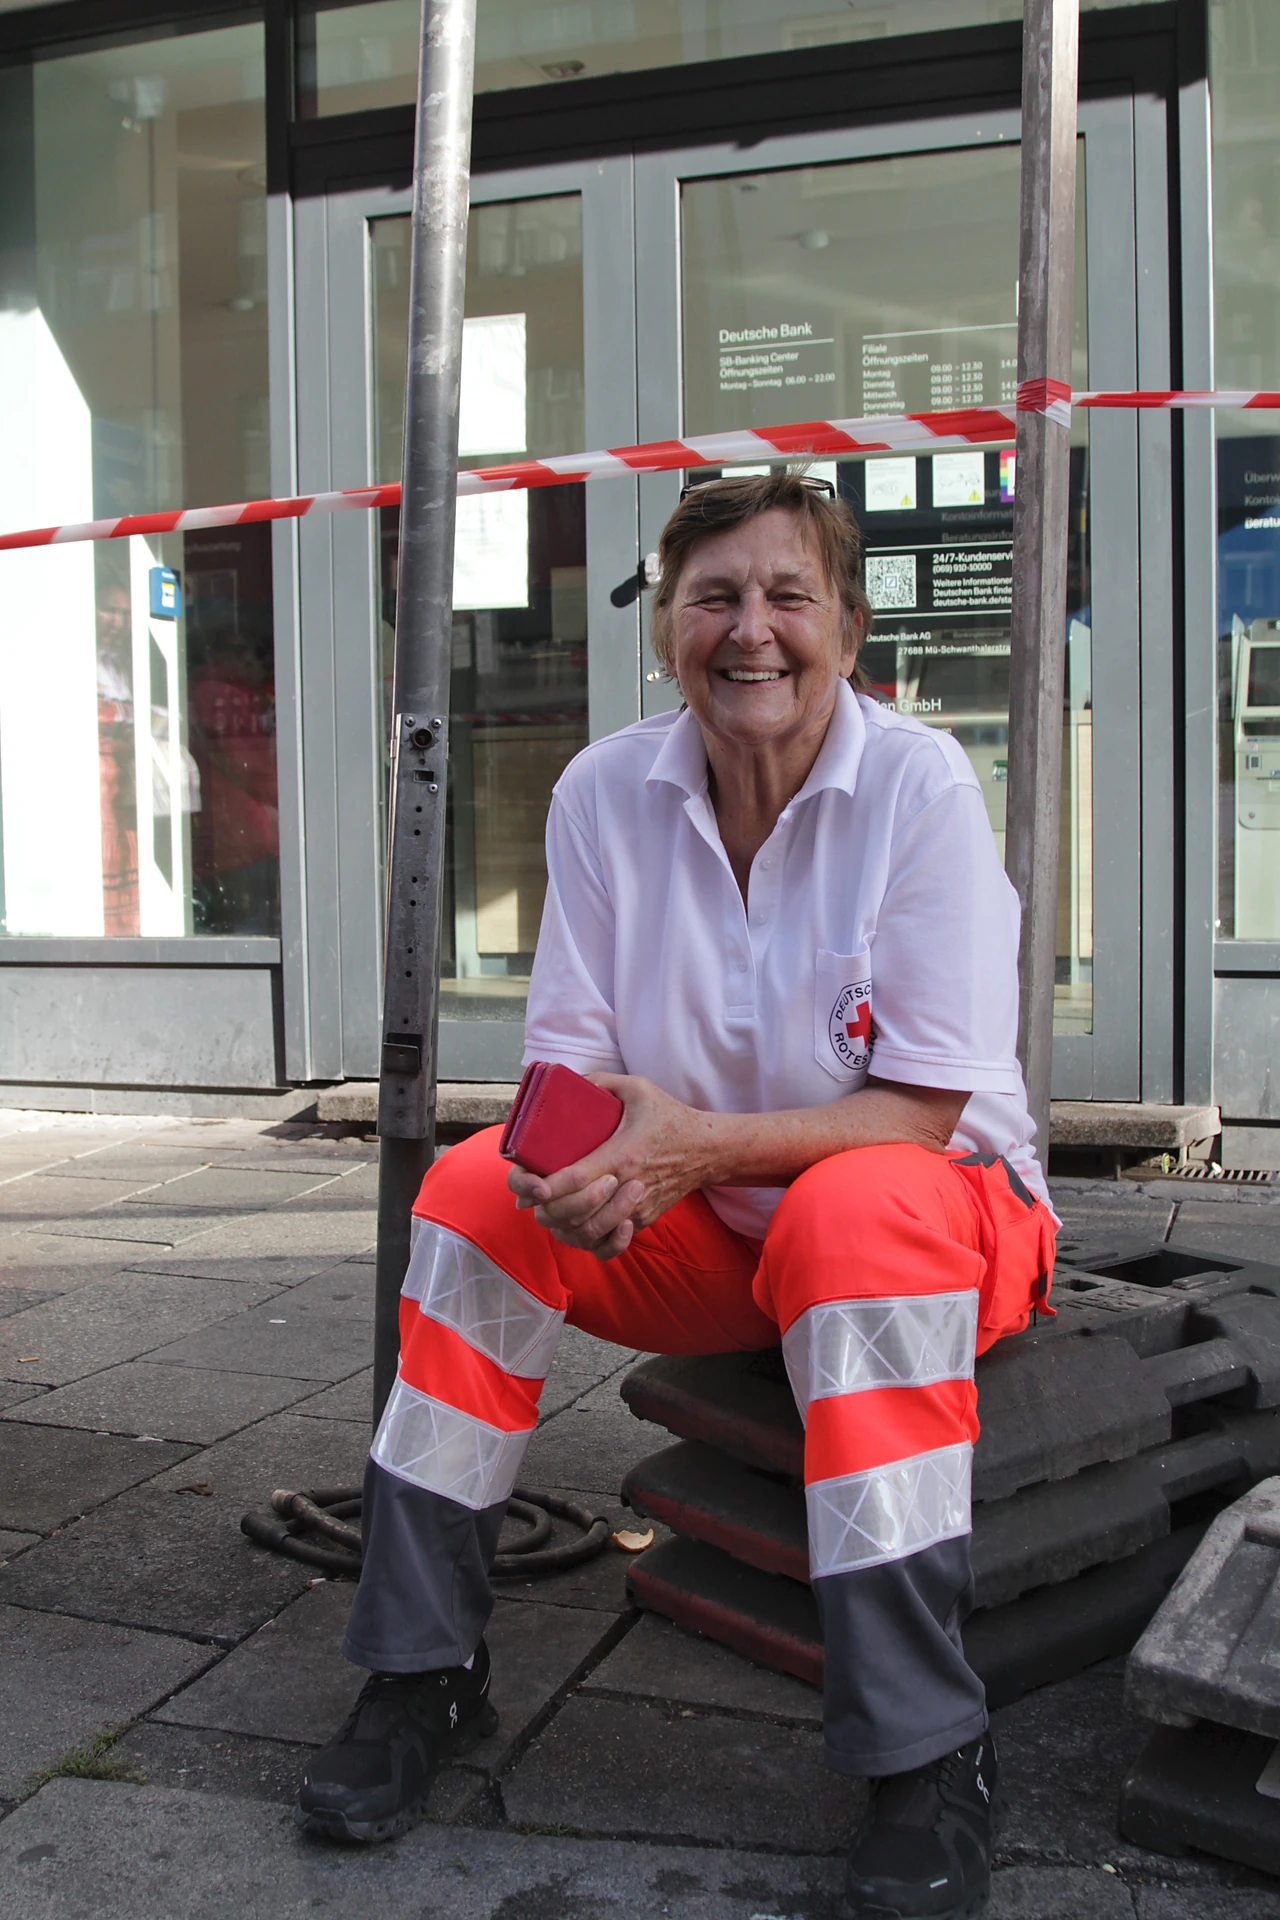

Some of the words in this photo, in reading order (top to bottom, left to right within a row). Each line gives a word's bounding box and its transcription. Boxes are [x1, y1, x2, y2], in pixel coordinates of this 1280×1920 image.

[719, 325, 778, 344] Deutsche
[780, 321, 813, 338] Bank
[862, 343, 887, 354] Filiale
[719, 354, 769, 368] SB-Banking
[770, 351, 799, 363] Center
[862, 352, 928, 367] Öffnungszeiten
[719, 364, 783, 379] Öffnungszeiten
[863, 370, 891, 379] Montag
[1001, 359, 1017, 369] 14.0
[814, 372, 836, 384] 22.00
[863, 380, 895, 390] Dienstag
[863, 390, 897, 400] Mittwoch
[1001, 380, 1017, 390] 14.0
[863, 401, 905, 411] Donnerstag
[1244, 469, 1280, 484] Überw
[1244, 493, 1280, 507] Kontoi
[941, 509, 1014, 522] Kontoinformat
[1244, 516, 1280, 529] Beratu
[942, 530, 1014, 543] Beratungsinfo
[933, 550, 1013, 564] 24/7-Kundenservi
[933, 564, 952, 575] (069)
[953, 562, 992, 573] 910-10000
[933, 578, 961, 588] Weitere
[933, 588, 972, 598] Deutschen
[973, 586, 992, 596] Bank
[993, 585, 1012, 595] finde
[933, 595, 1012, 607] deutsche-bank.de/sta
[866, 632, 900, 643] Deutsche
[900, 631, 918, 642] Bank
[919, 631, 931, 640] AG
[925, 643, 1011, 655] Mü-Schwanthalerstra
[900, 698, 942, 712] GmbH
[836, 983, 872, 1021] DEUTSC
[834, 1032, 868, 1066] ROTES
